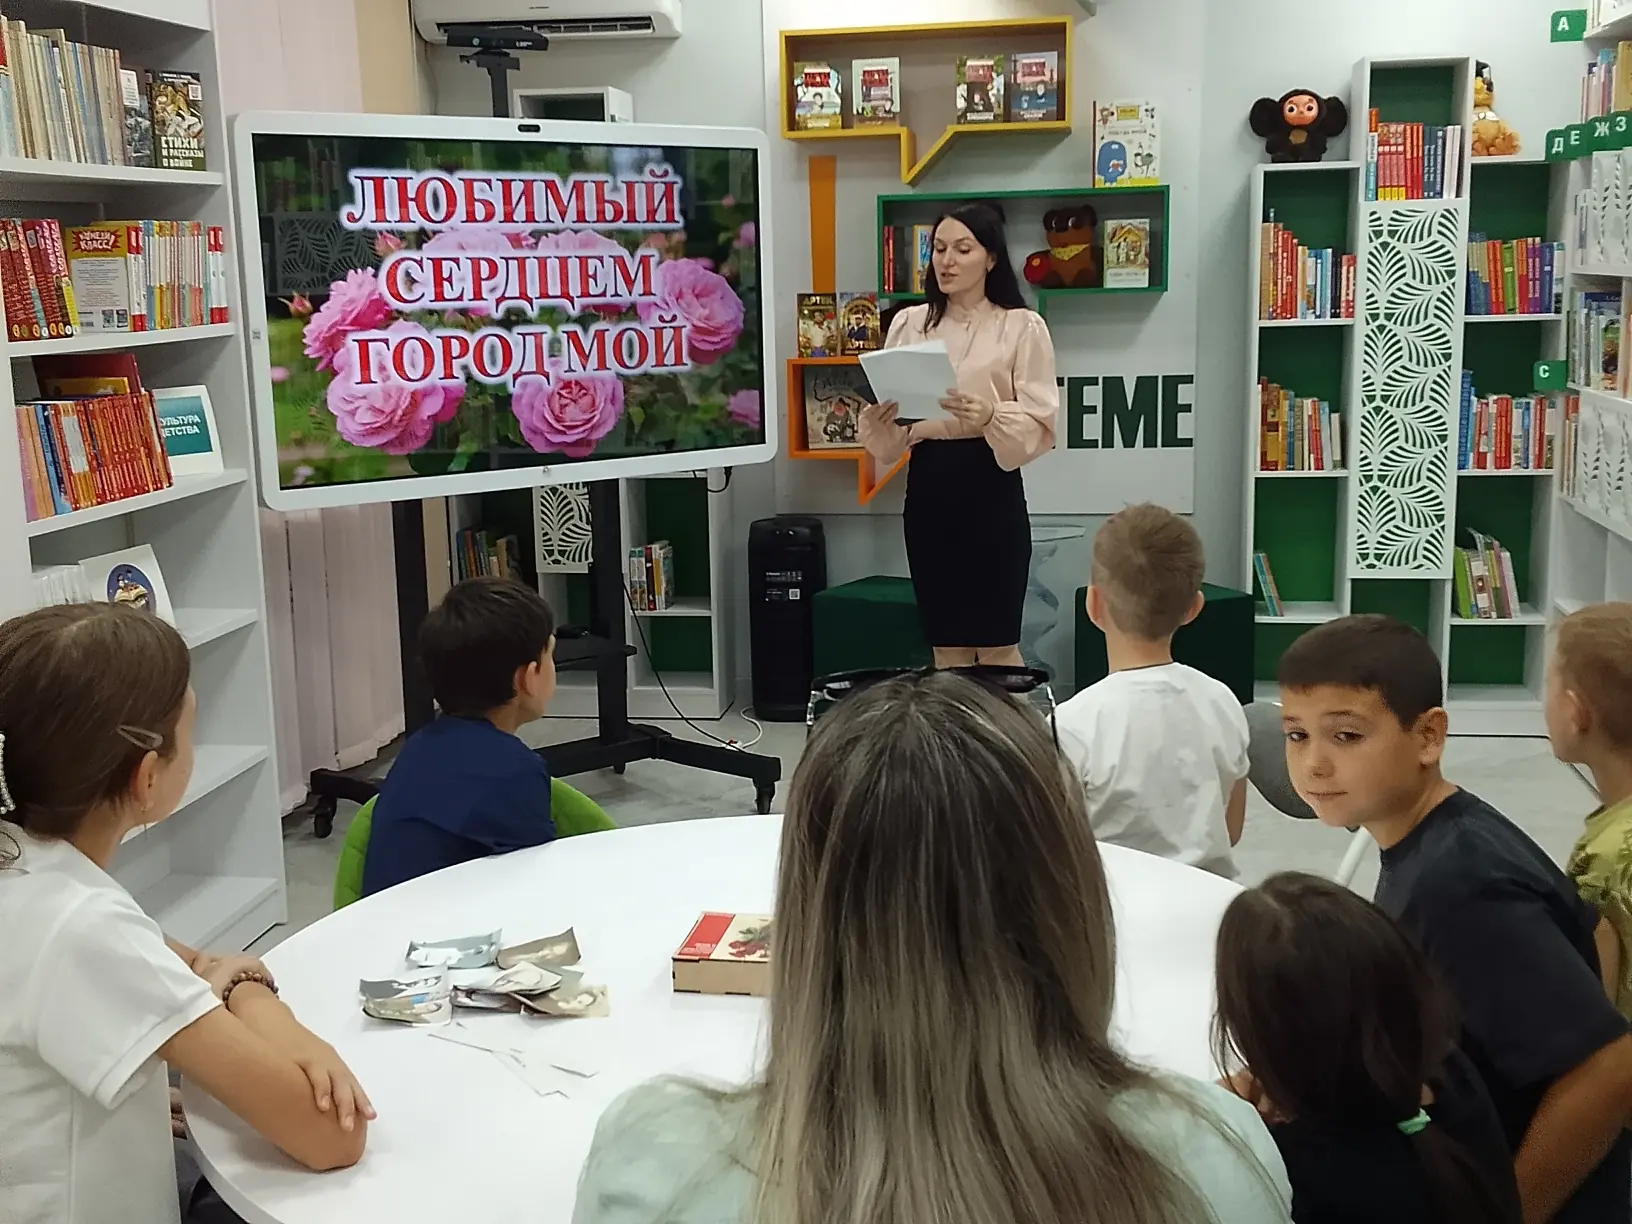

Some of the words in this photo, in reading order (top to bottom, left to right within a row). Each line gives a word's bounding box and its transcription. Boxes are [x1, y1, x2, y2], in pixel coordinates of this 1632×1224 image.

[1557, 16, 1570, 31] А
[1594, 121, 1610, 137] Ж
[161, 136, 198, 149] СТИХИ
[1551, 137, 1564, 154] Д
[1570, 131, 1580, 145] Е
[345, 167, 682, 225] ЛЮБИМЫЙ
[384, 253, 658, 313] СЕРДЦЕМ
[353, 329, 551, 389] ГОРОД
[564, 313, 689, 373] МОЙ
[1538, 365, 1550, 379] С
[1056, 374, 1194, 449] ЕМЕ
[158, 414, 201, 427] УЛЬТУРА
